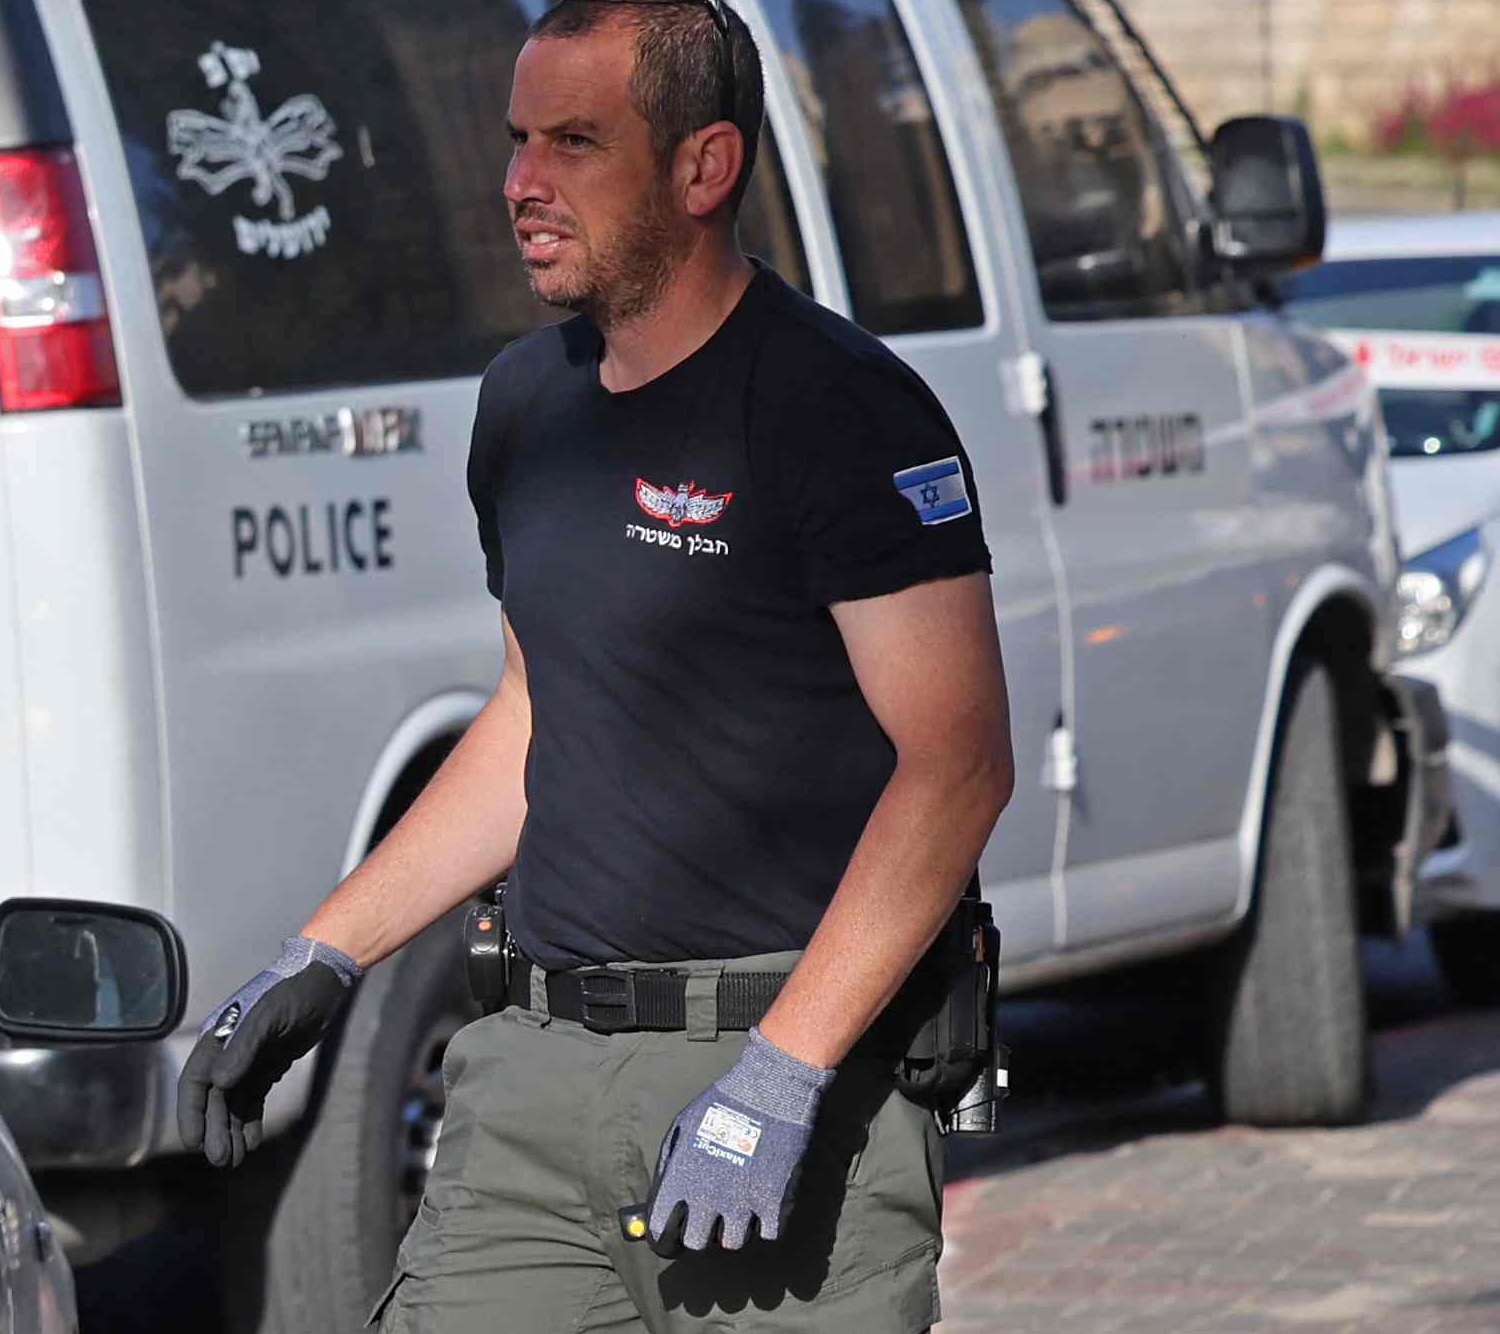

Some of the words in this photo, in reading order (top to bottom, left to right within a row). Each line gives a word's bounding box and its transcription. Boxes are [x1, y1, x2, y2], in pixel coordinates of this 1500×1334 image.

[233, 498, 394, 581] POLICE
[626, 524, 682, 549] משטרה
[687, 534, 729, 555] חבלן
